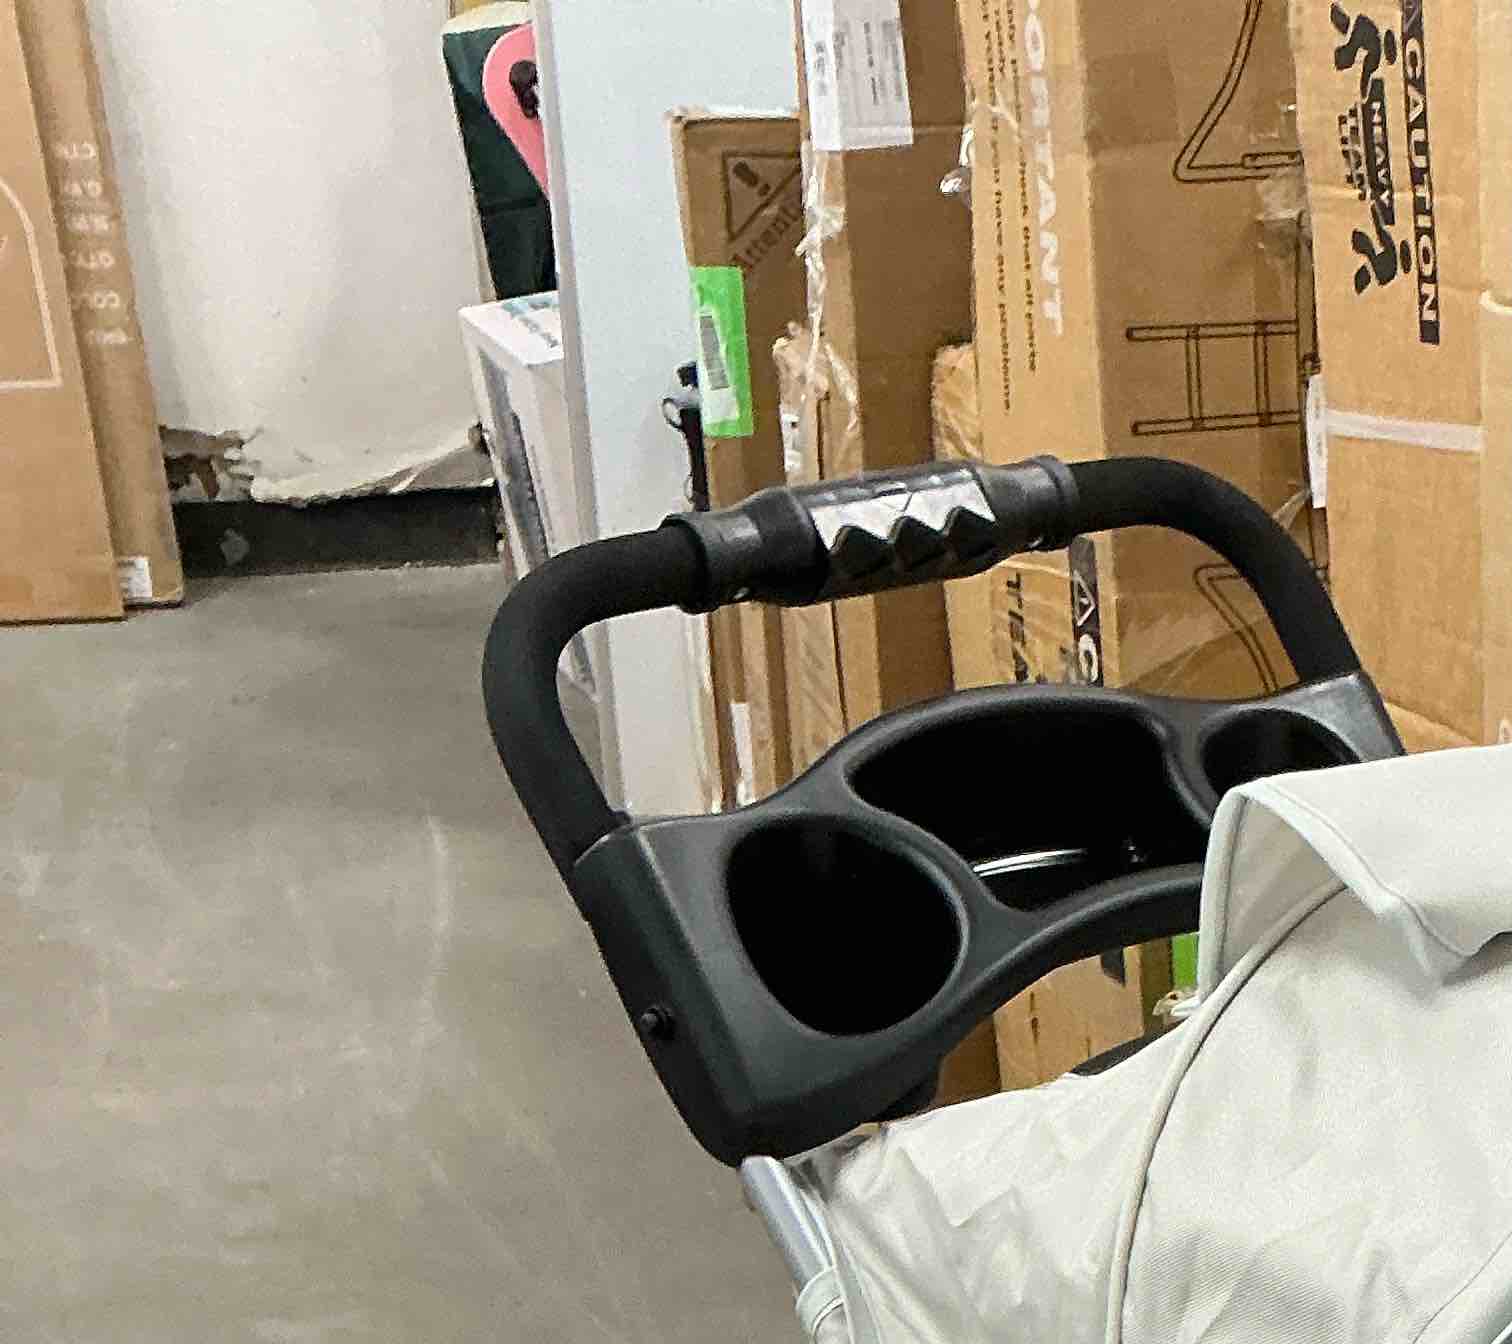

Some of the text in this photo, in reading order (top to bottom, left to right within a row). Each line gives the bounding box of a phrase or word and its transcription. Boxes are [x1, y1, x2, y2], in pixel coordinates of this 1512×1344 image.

[1024, 0, 1063, 335] ORTANT
[1371, 100, 1391, 206] HEAVY
[1404, 37, 1437, 321] CAUTION
